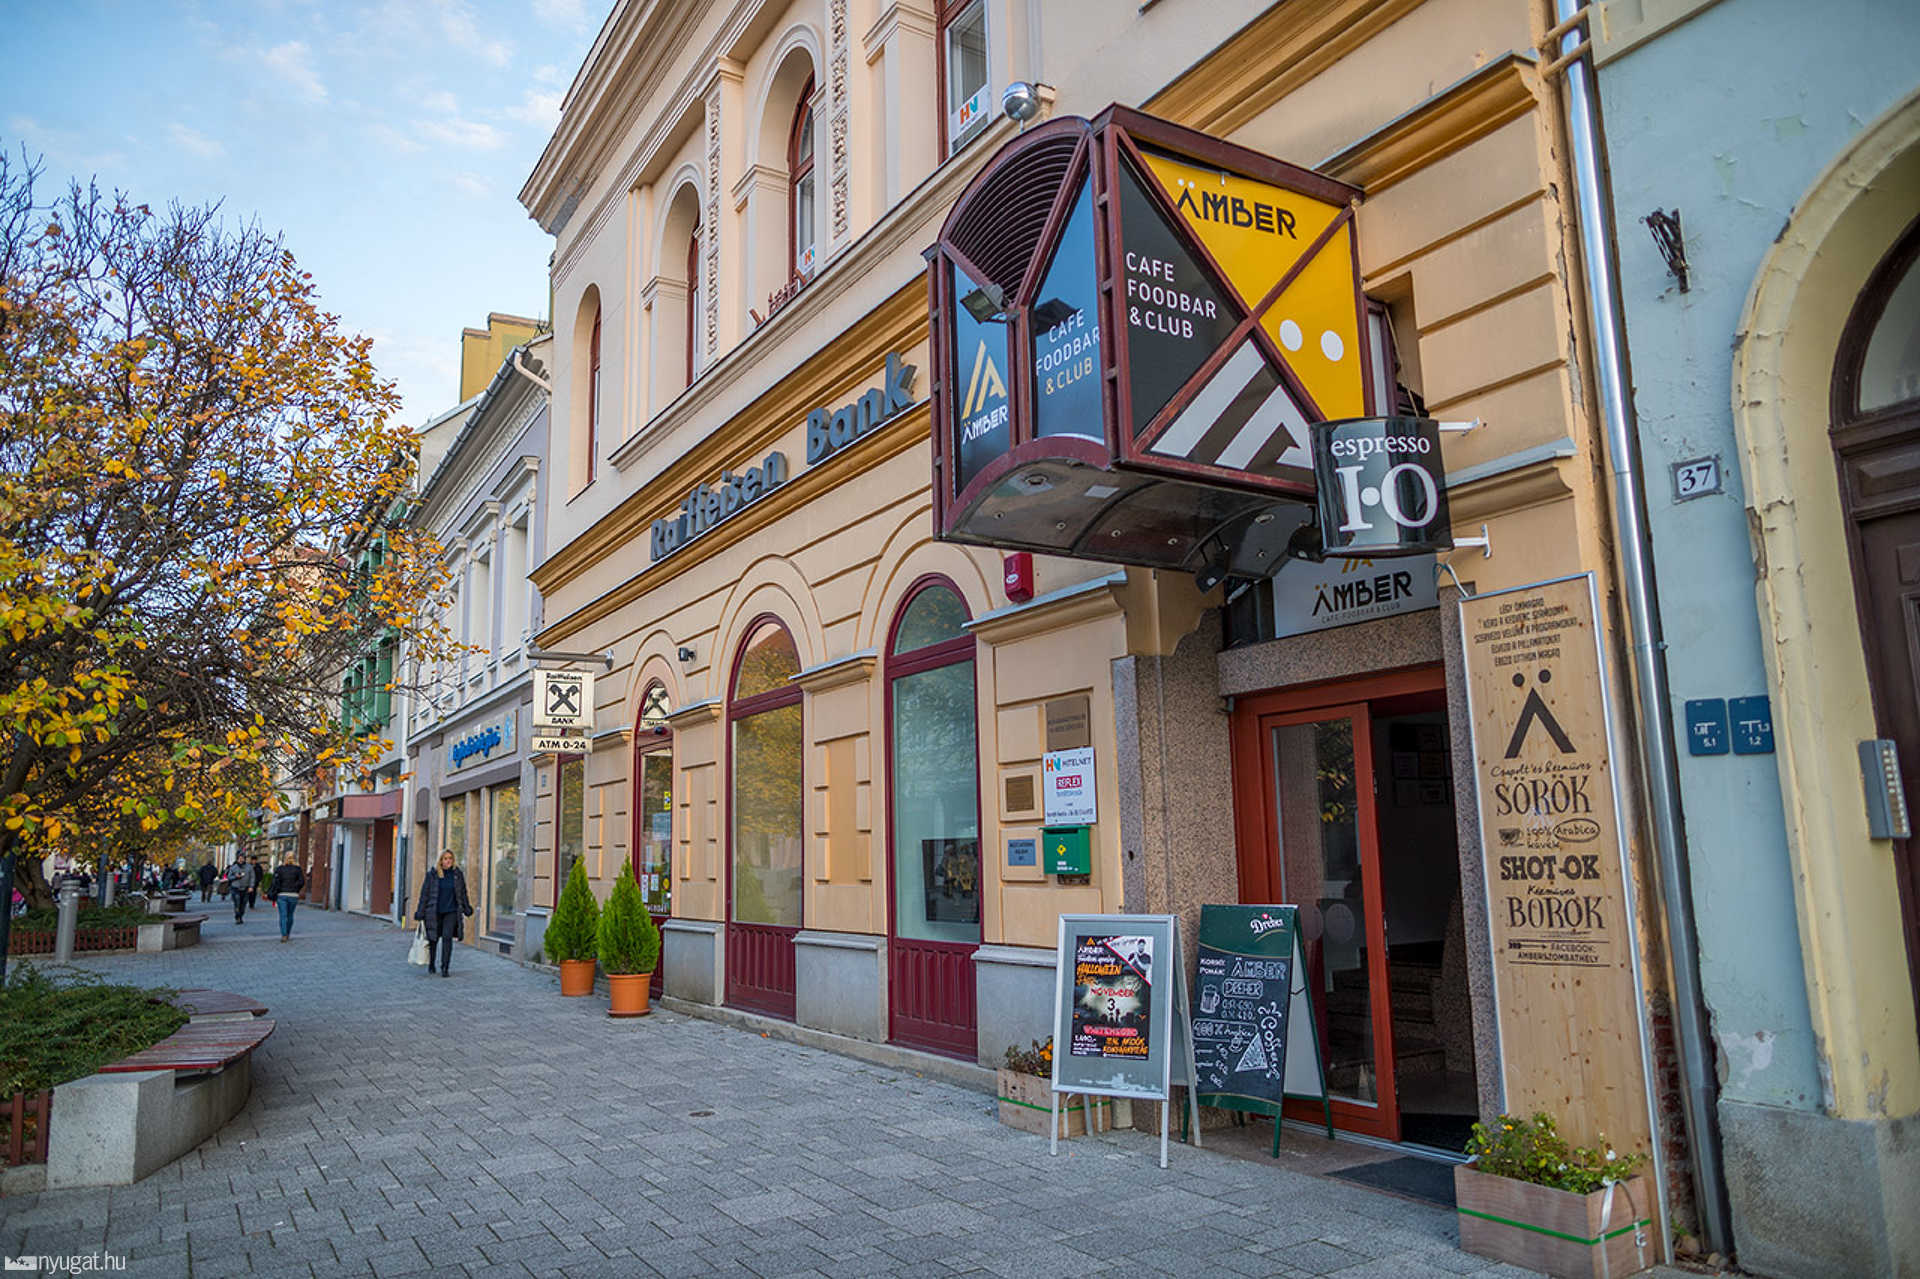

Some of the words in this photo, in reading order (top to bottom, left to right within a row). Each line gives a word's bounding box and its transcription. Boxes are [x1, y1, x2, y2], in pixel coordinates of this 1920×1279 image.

[1177, 179, 1297, 240] ÄMBER
[1126, 252, 1174, 282] CAFE
[1127, 279, 1216, 319] FOODBAR
[1049, 309, 1084, 343] CAFE
[1036, 327, 1100, 376] FOODBAR
[650, 451, 789, 561] Raiffeisen
[807, 352, 918, 464] Bank
[1331, 436, 1430, 461] espresso
[1681, 464, 1712, 491] 37
[1312, 571, 1412, 616] ÄMBER
[551, 717, 574, 725] BANK
[538, 739, 560, 748] ATM
[563, 740, 586, 749] 0-24
[1495, 774, 1592, 816] SÖRÖK
[1500, 855, 1600, 880] SHOT-OK
[1250, 916, 1284, 934] Dreher
[1506, 896, 1606, 929] BOROK
[1232, 957, 1286, 980] ÄMBER
[1091, 988, 1135, 997] NOVEMBER
[1225, 981, 1261, 995] DREHER
[1107, 998, 1115, 1013] 3
